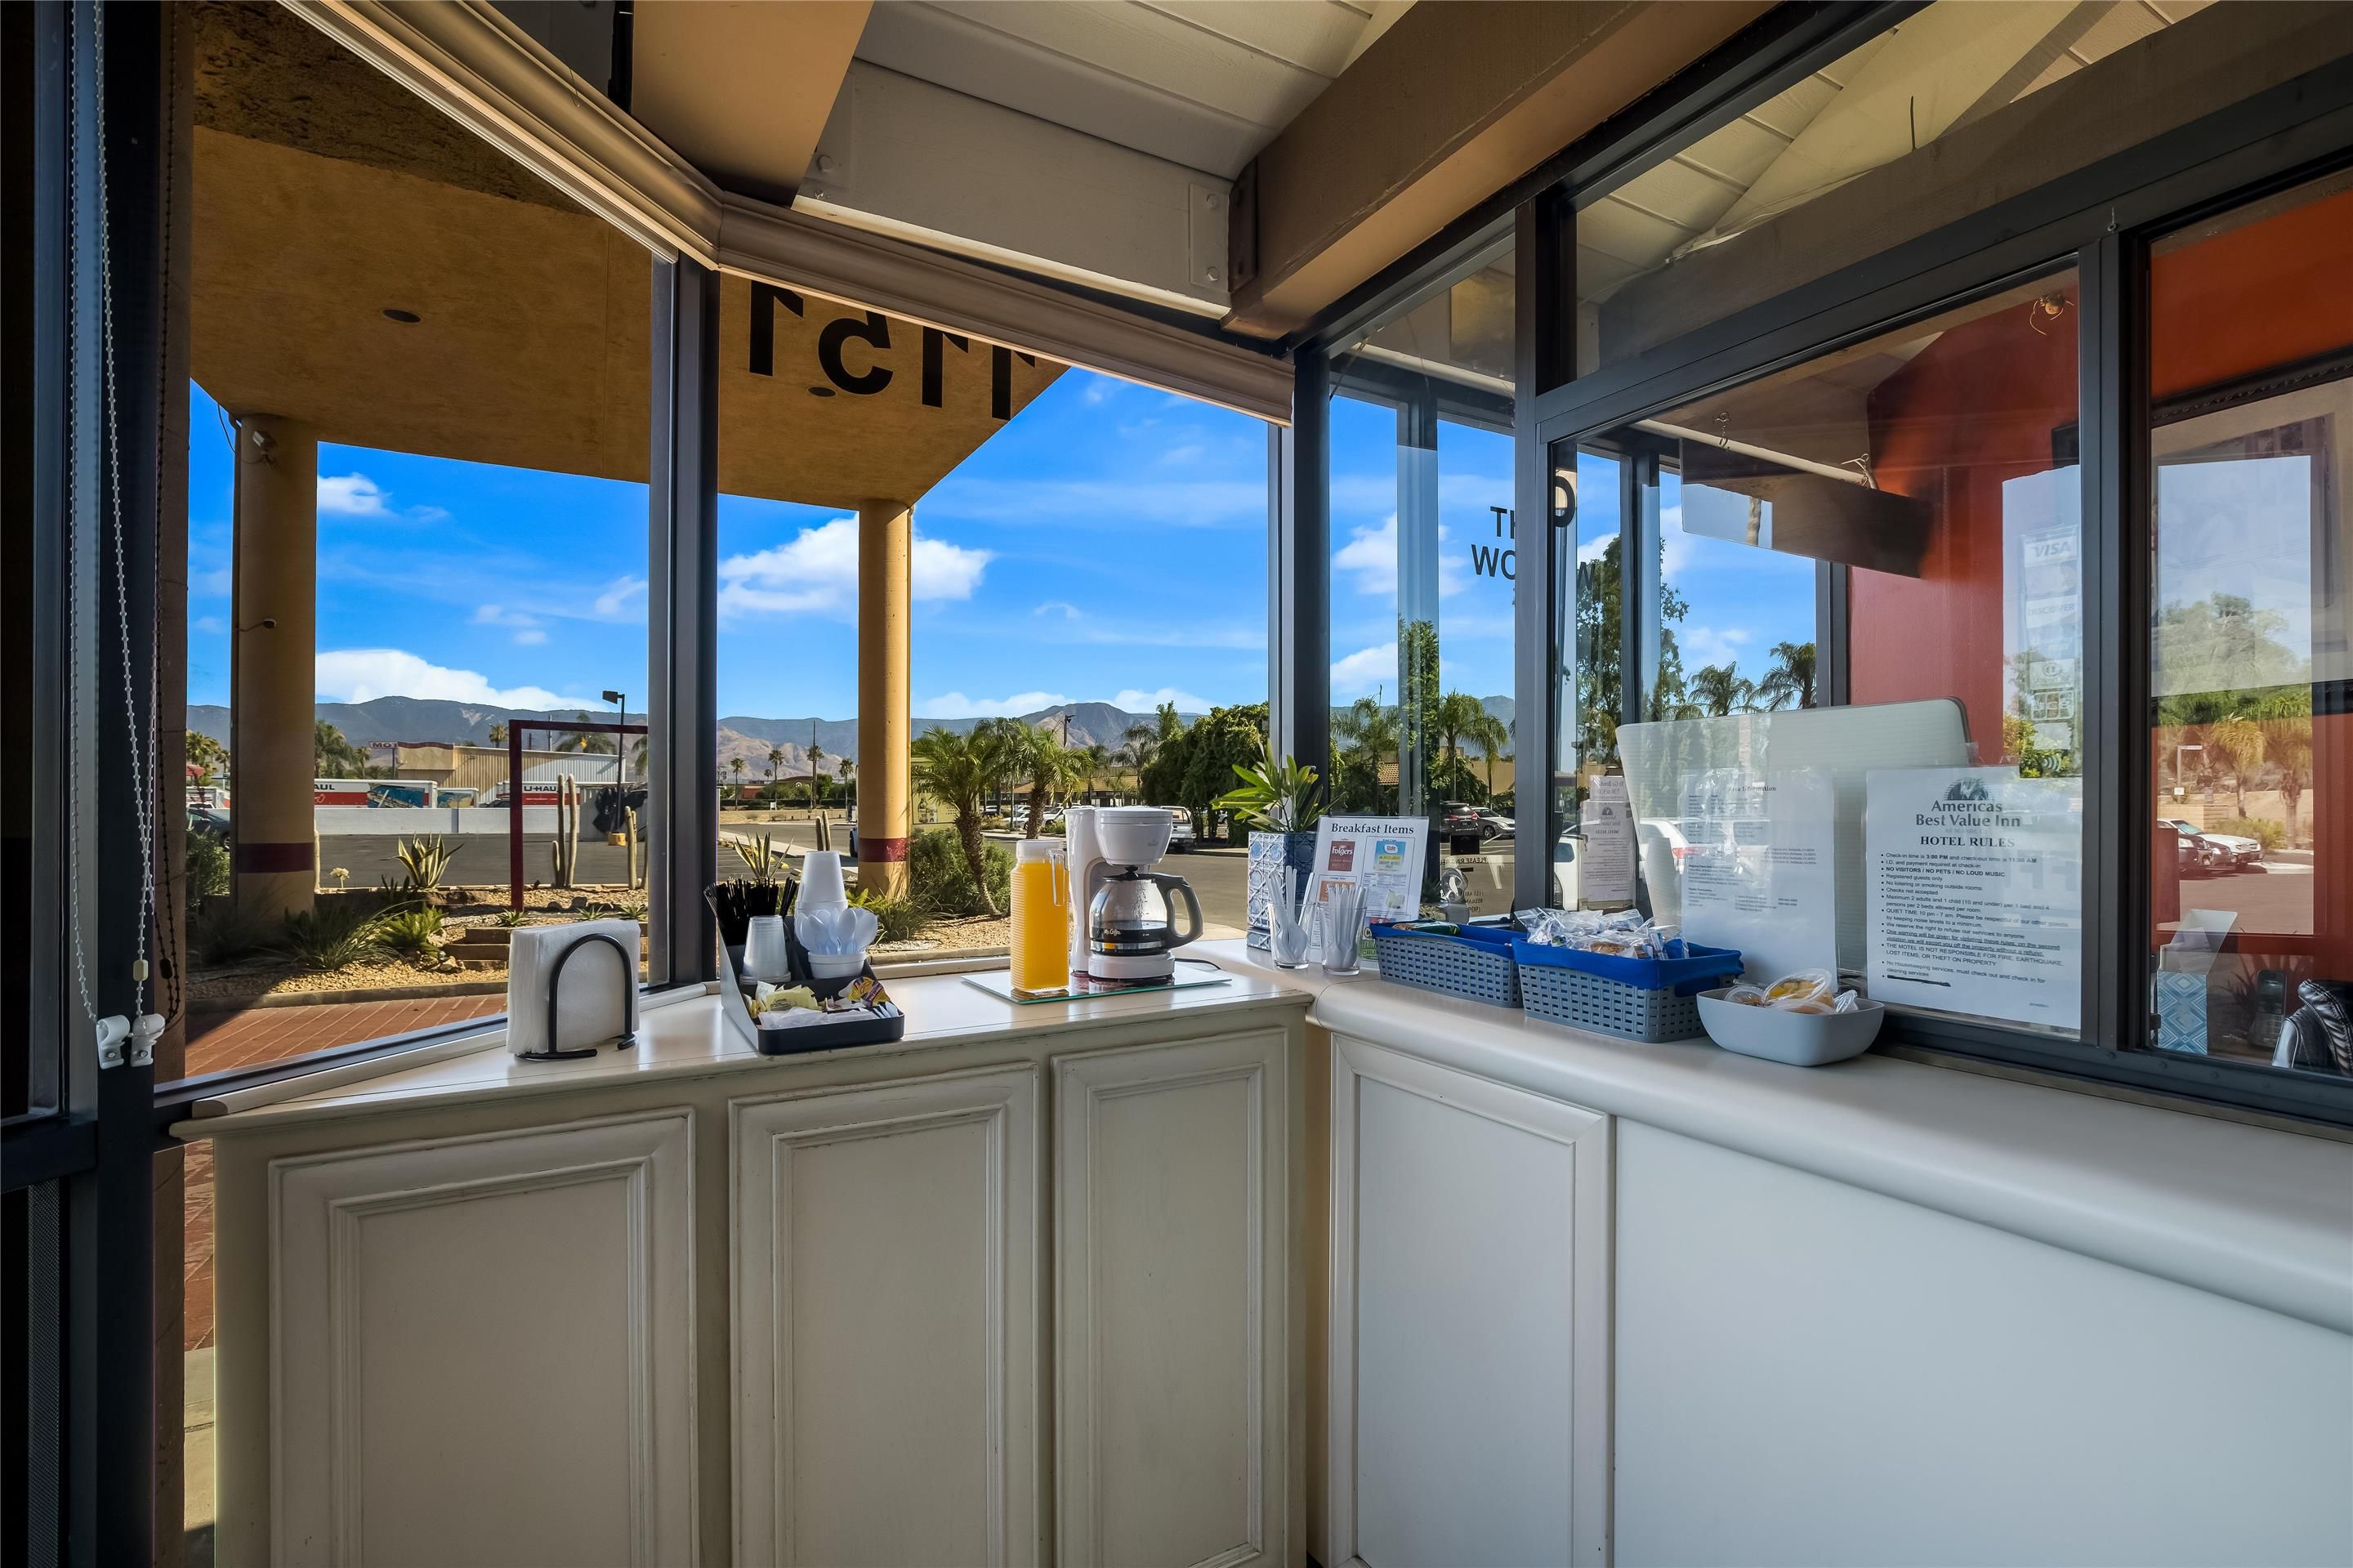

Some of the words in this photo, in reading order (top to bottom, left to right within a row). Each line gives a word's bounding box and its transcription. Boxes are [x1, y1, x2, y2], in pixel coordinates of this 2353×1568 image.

[2030, 541, 2071, 557] VISA
[1931, 800, 2003, 812] Americas
[1915, 814, 1946, 826] Best
[1949, 814, 1991, 827] Value
[1995, 815, 2020, 827] Inn
[1331, 823, 1382, 834] Breakfast
[1384, 824, 1414, 834] Items
[1920, 836, 1966, 847] HOTEL
[1969, 837, 2016, 847] RULES
[1332, 846, 1353, 856] Folgers
[1939, 948, 1981, 958] RESPONSIBLE
